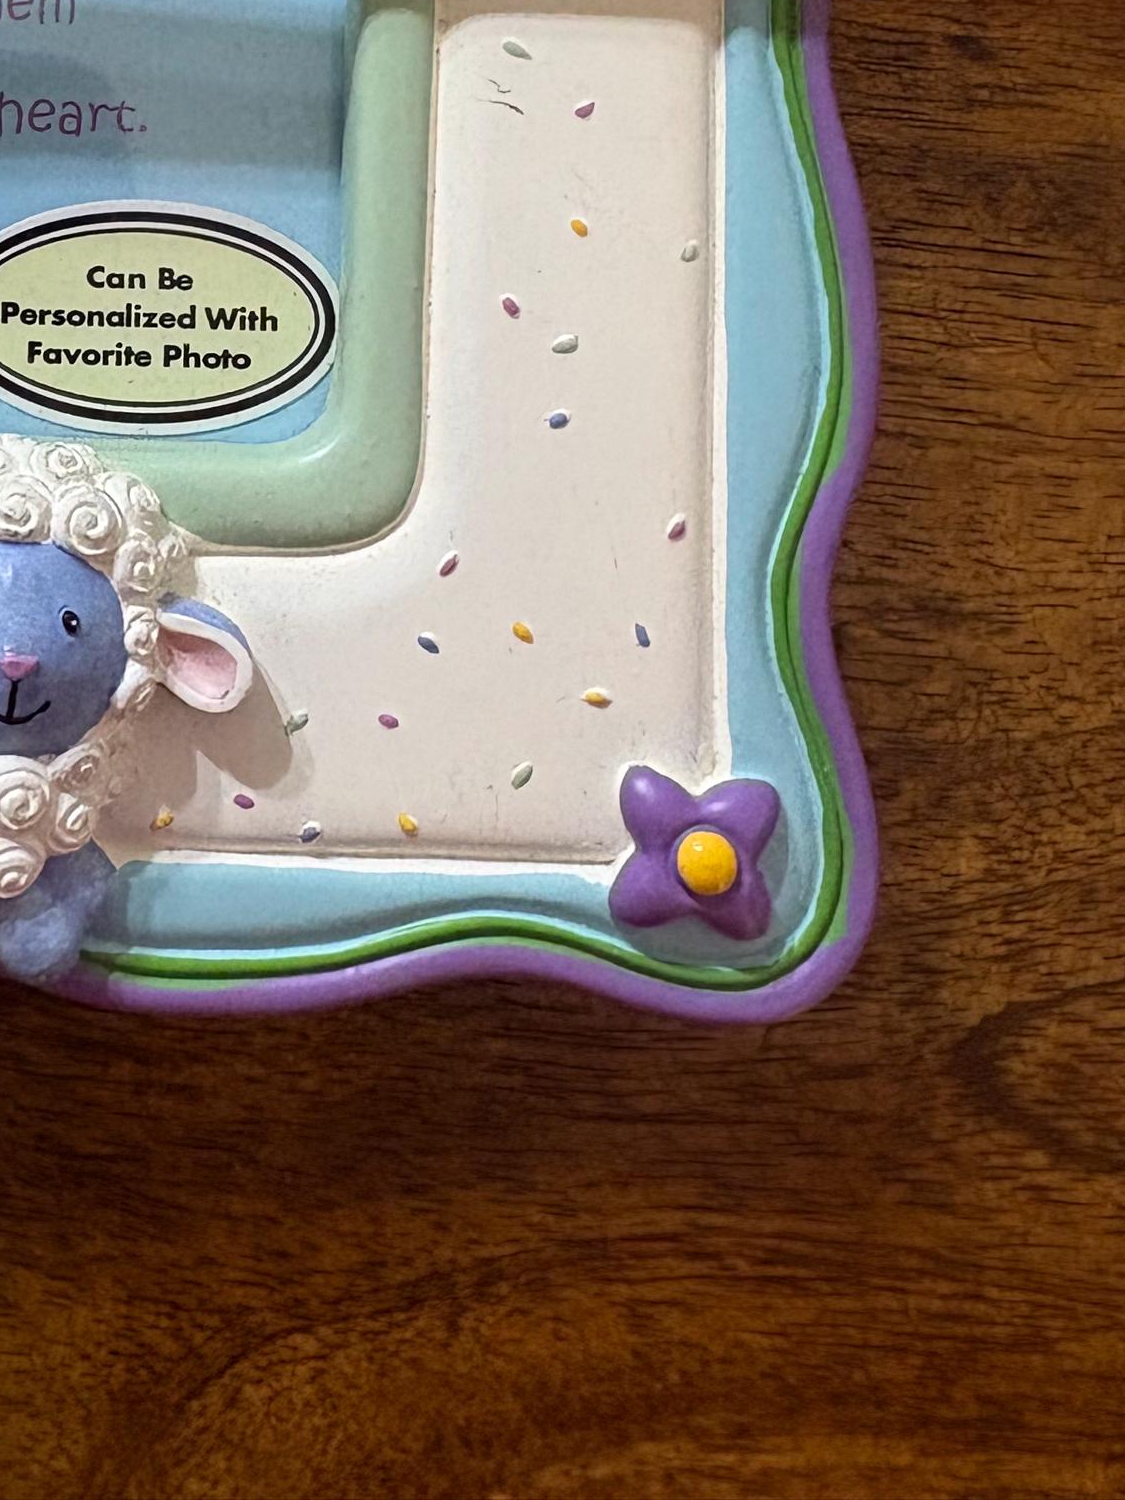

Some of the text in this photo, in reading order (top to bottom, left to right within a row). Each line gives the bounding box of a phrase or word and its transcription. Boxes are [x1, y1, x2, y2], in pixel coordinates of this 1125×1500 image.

[87, 266, 193, 291] Can Be
[1, 302, 278, 331] Personalized With
[27, 341, 251, 369] Favorite Photo
